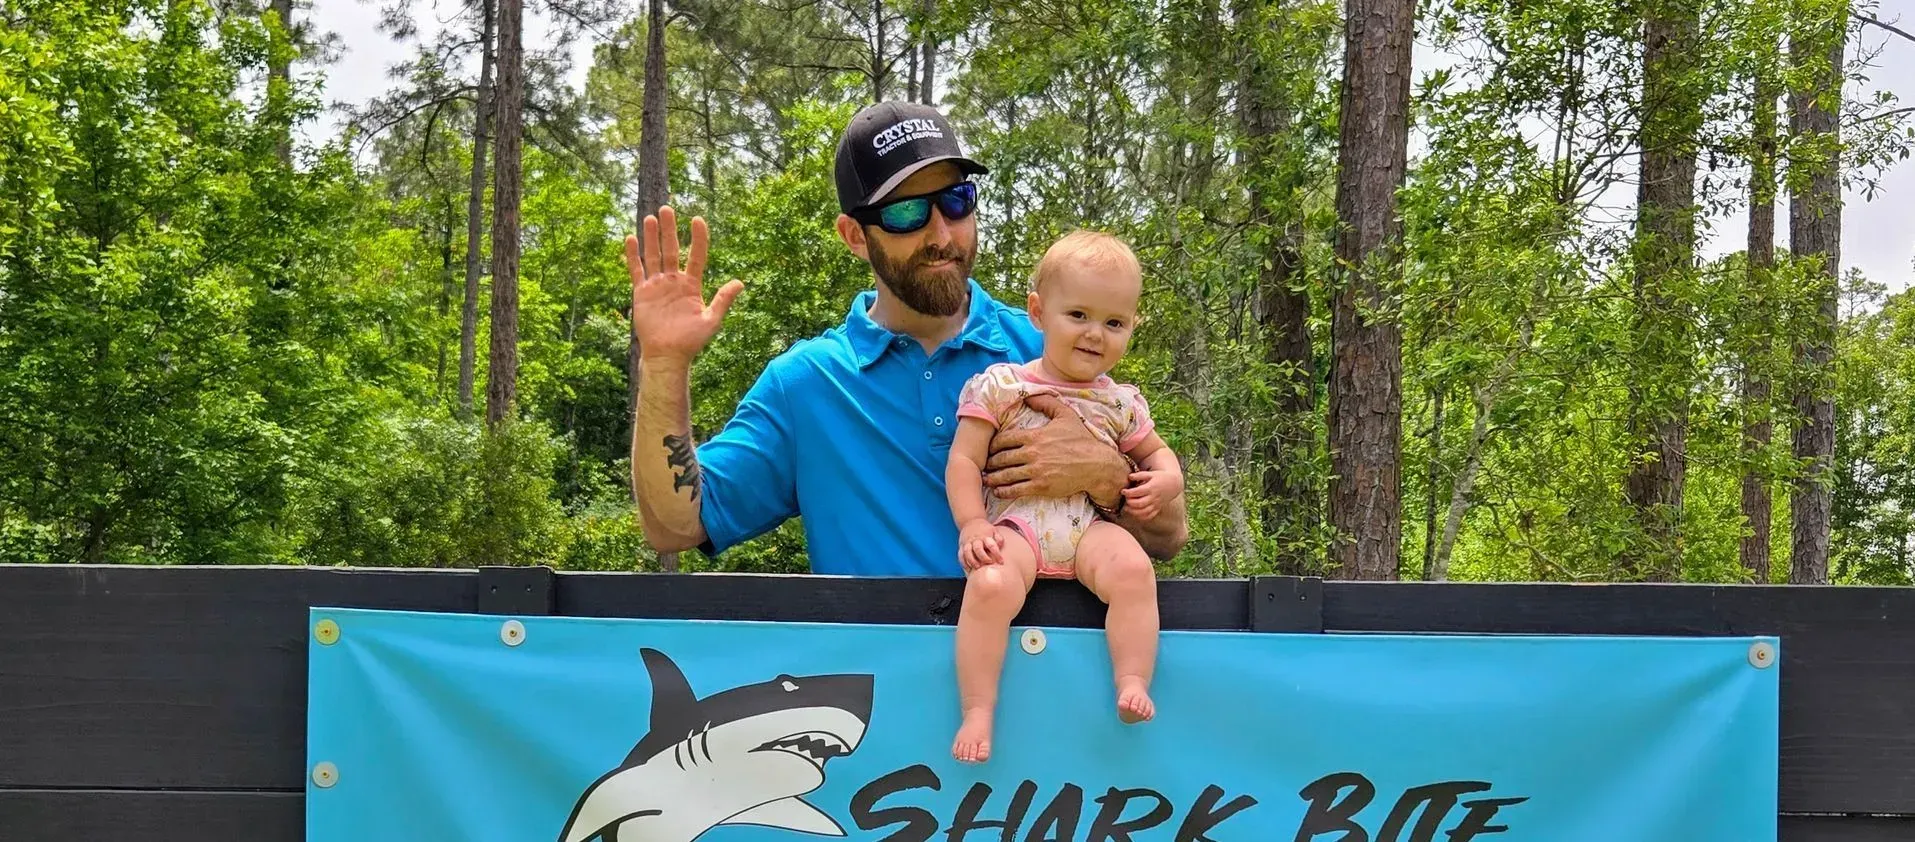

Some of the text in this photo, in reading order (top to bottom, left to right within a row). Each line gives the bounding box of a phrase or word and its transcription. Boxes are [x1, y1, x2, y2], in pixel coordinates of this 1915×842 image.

[873, 119, 939, 148] CRYSTAL
[877, 138, 906, 156] TRACTOR
[849, 764, 1530, 842] SHARK BITE
